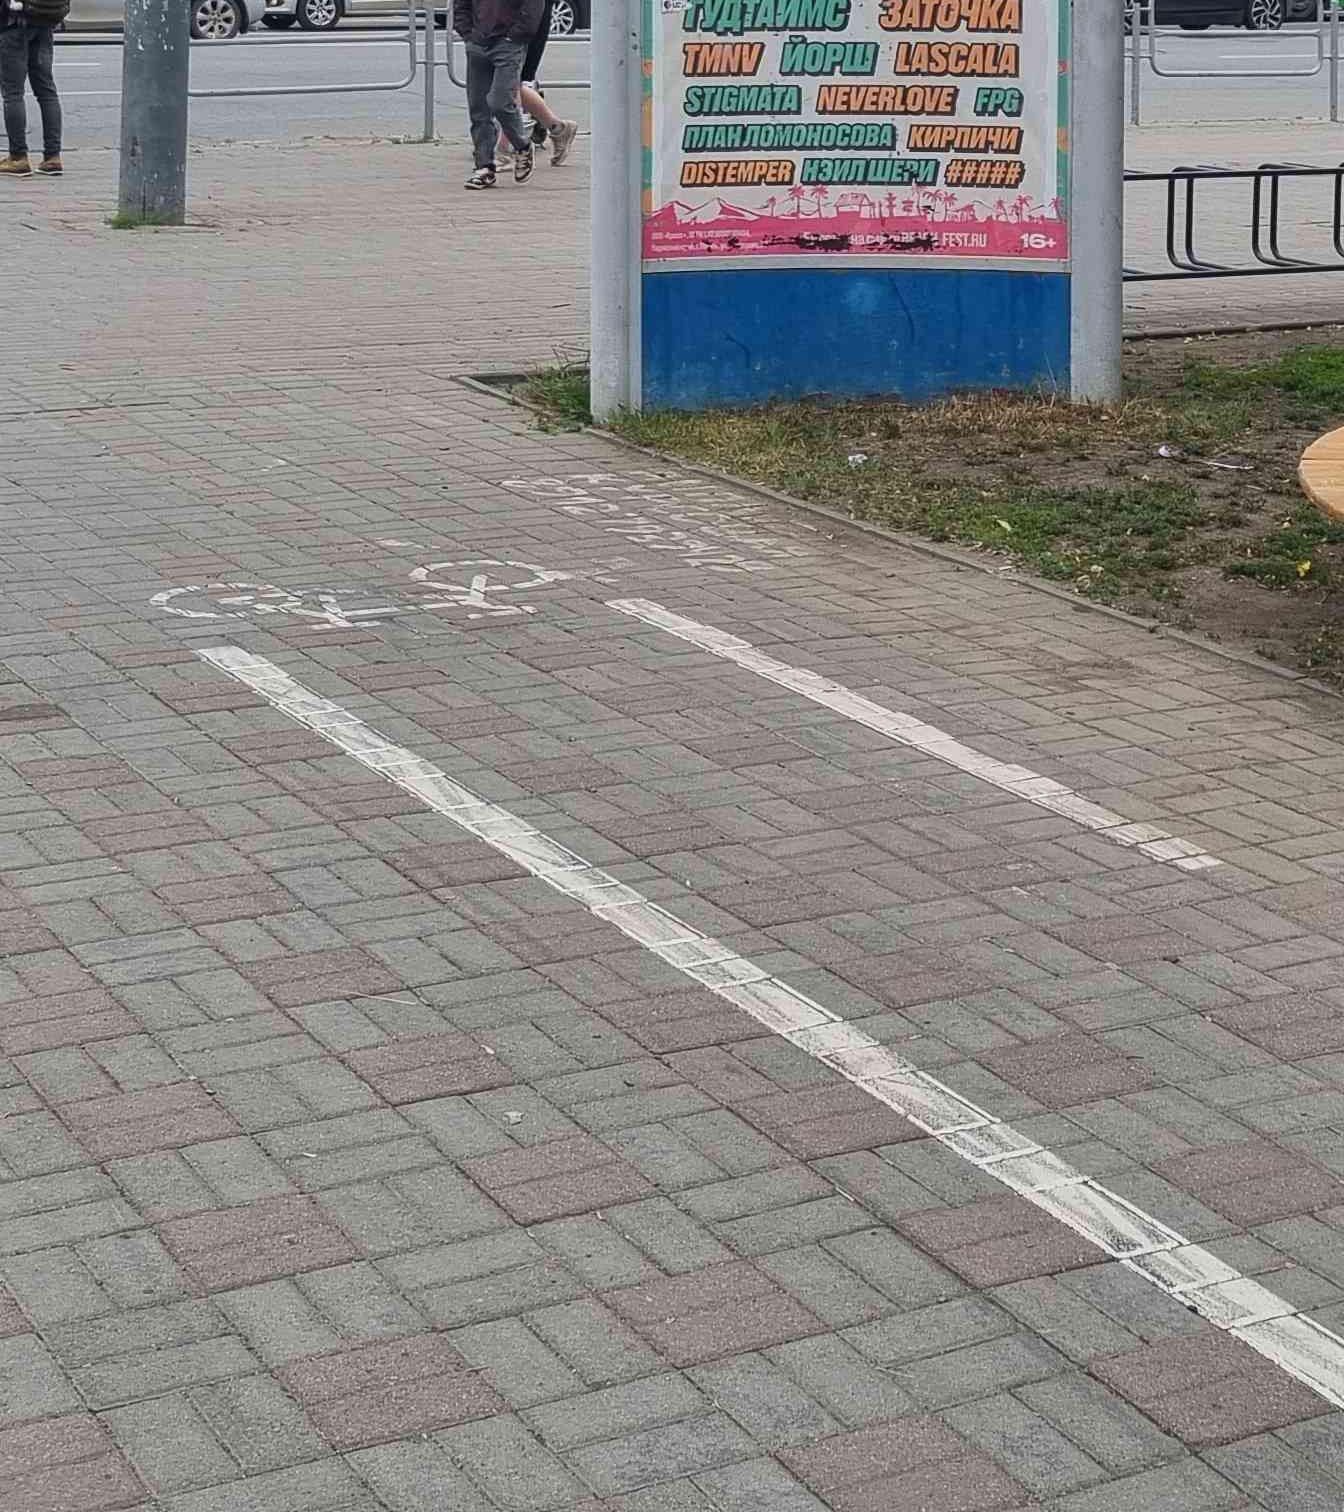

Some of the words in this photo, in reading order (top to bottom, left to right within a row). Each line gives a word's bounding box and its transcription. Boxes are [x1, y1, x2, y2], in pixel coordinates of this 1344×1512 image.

[683, 42, 765, 77] TMNV
[780, 34, 879, 76] ЙОРШ
[894, 42, 1020, 77] LASCALA
[683, 85, 802, 116] STIGMATA
[816, 85, 958, 115] NEVERLOVE
[974, 86, 1024, 117] FPG
[682, 124, 745, 152] ПЛАН
[744, 124, 896, 152] ЛОМОНОСОВА
[907, 125, 1024, 153] КИРПИЧИ
[680, 160, 796, 187] DISTEMPER
[867, 158, 940, 186] ШЕРИ
[1020, 233, 1056, 249] 16+
